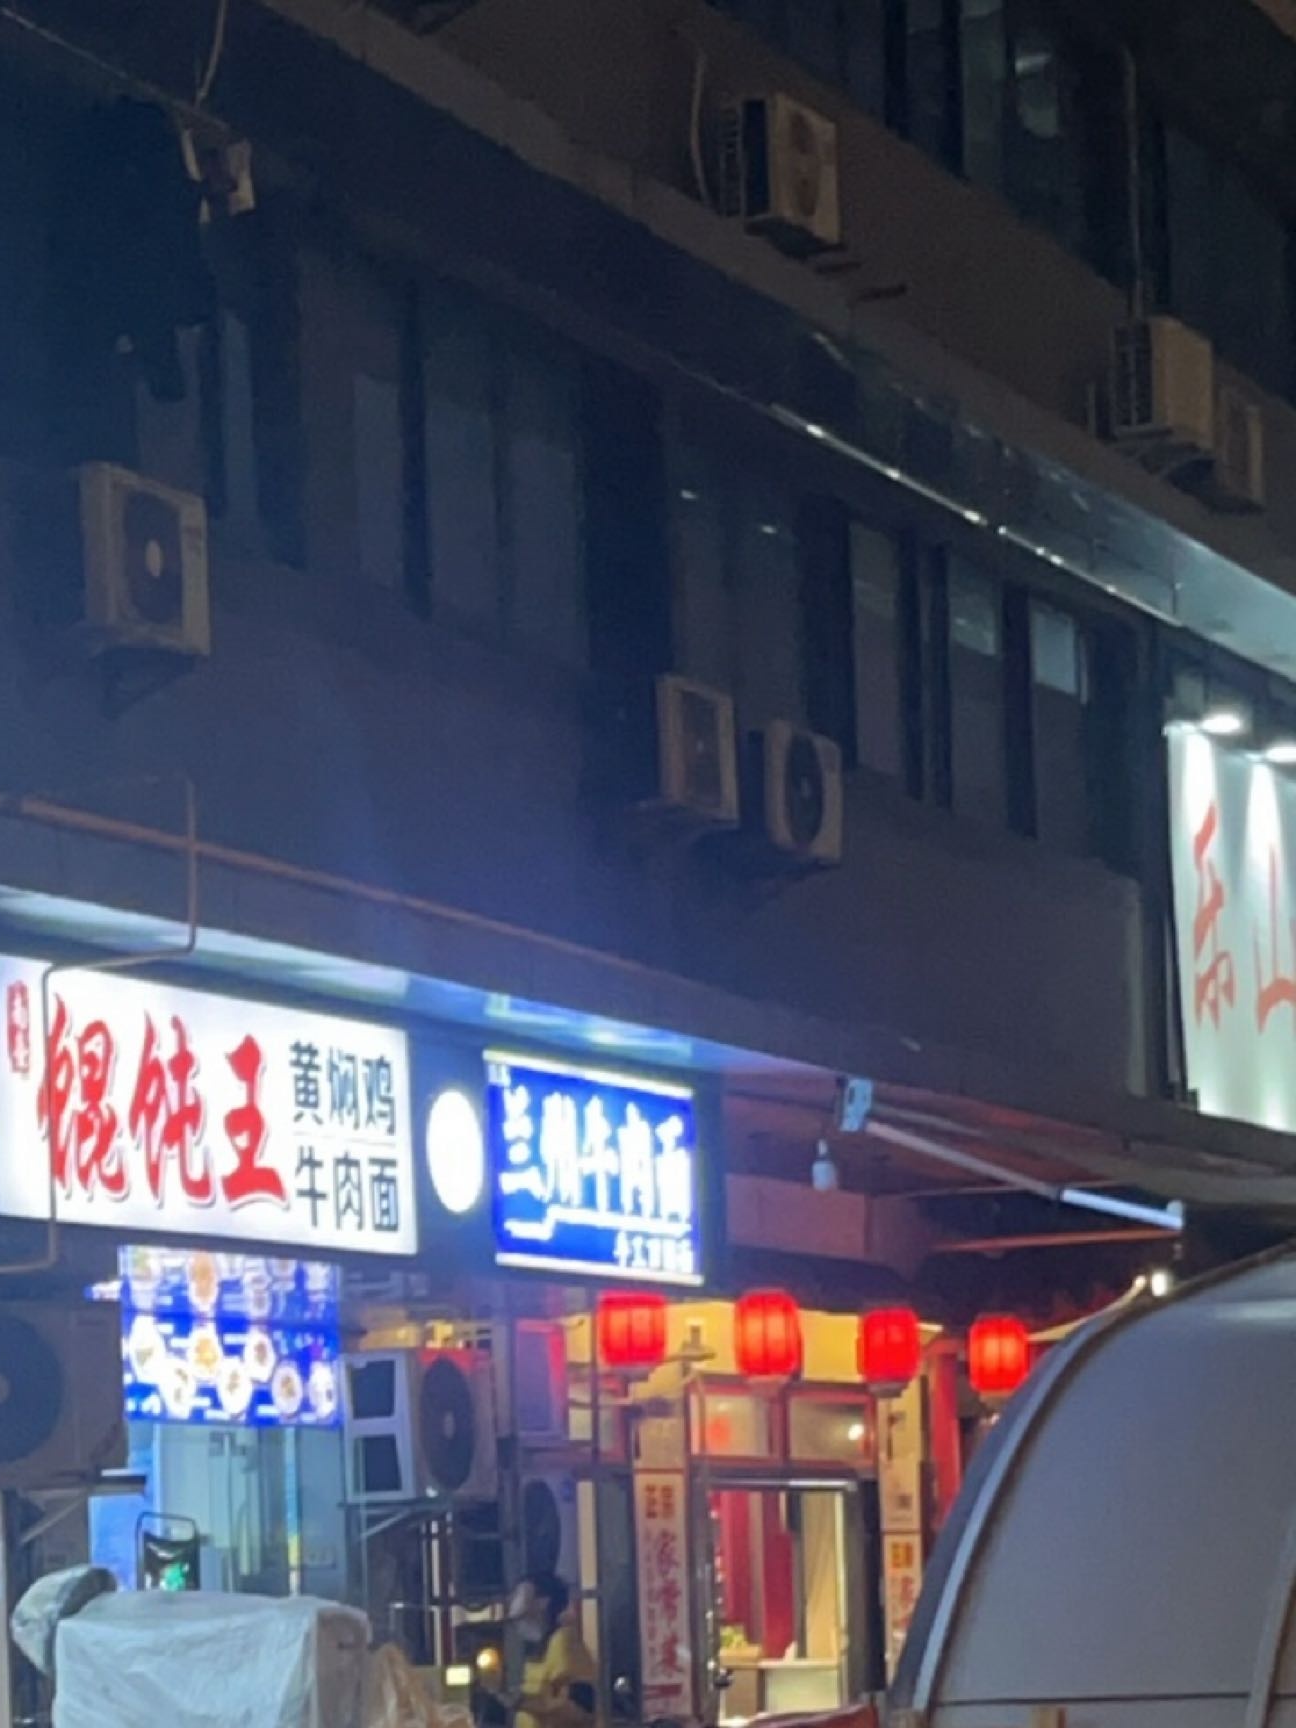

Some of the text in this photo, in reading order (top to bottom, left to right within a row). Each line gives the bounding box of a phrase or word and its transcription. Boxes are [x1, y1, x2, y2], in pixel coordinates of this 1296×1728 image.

[37, 993, 287, 1206] 馄饨王
[289, 1041, 397, 1138] 黄焖鸡
[293, 1146, 401, 1234] 牛肉面
